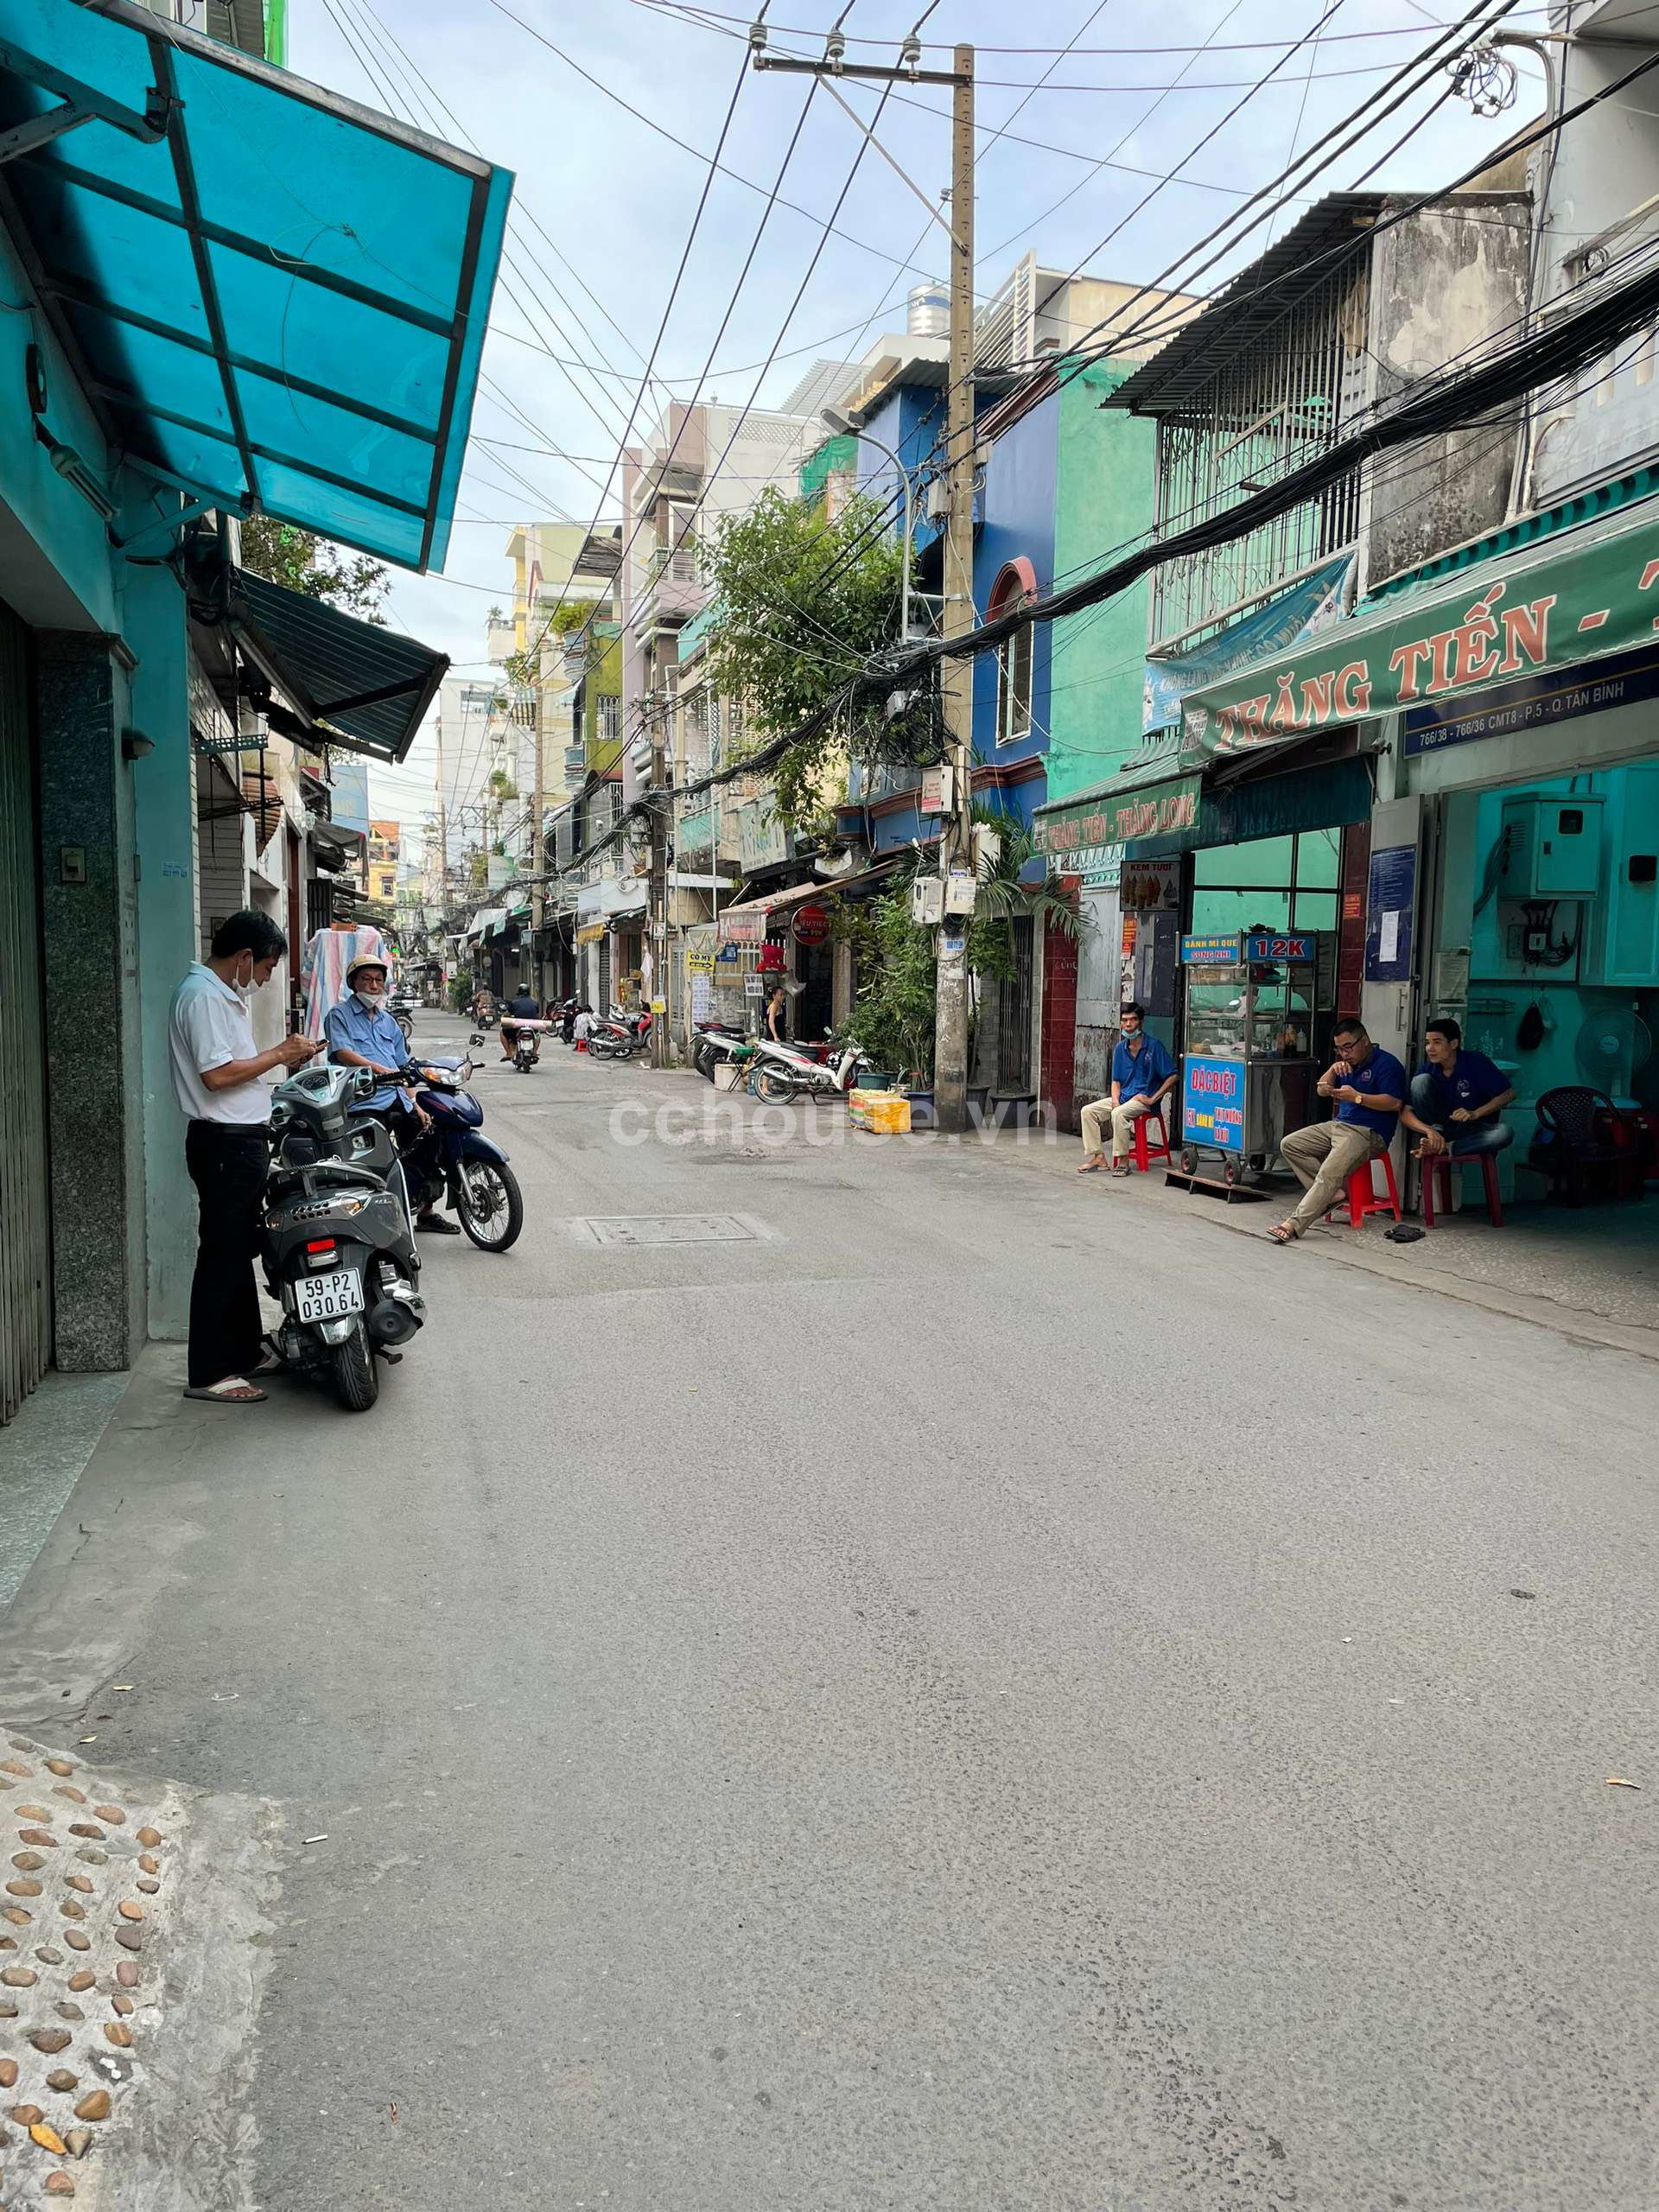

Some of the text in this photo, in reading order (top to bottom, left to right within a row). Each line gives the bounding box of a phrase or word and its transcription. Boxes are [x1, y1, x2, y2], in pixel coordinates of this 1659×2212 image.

[1214, 659, 1372, 751] THĂNG
[1389, 582, 1557, 703] TIẾN
[1456, 718, 1484, 737] 766/36
[1488, 710, 1516, 728] CMT8
[1525, 703, 1541, 719] P.5
[1593, 681, 1624, 702] BÌNH
[1116, 798, 1159, 838] THĂNG
[1160, 792, 1196, 830] LONG
[1255, 939, 1306, 957] 12K
[305, 1274, 351, 1298] 59-P2
[302, 1291, 359, 1319] 030.64
